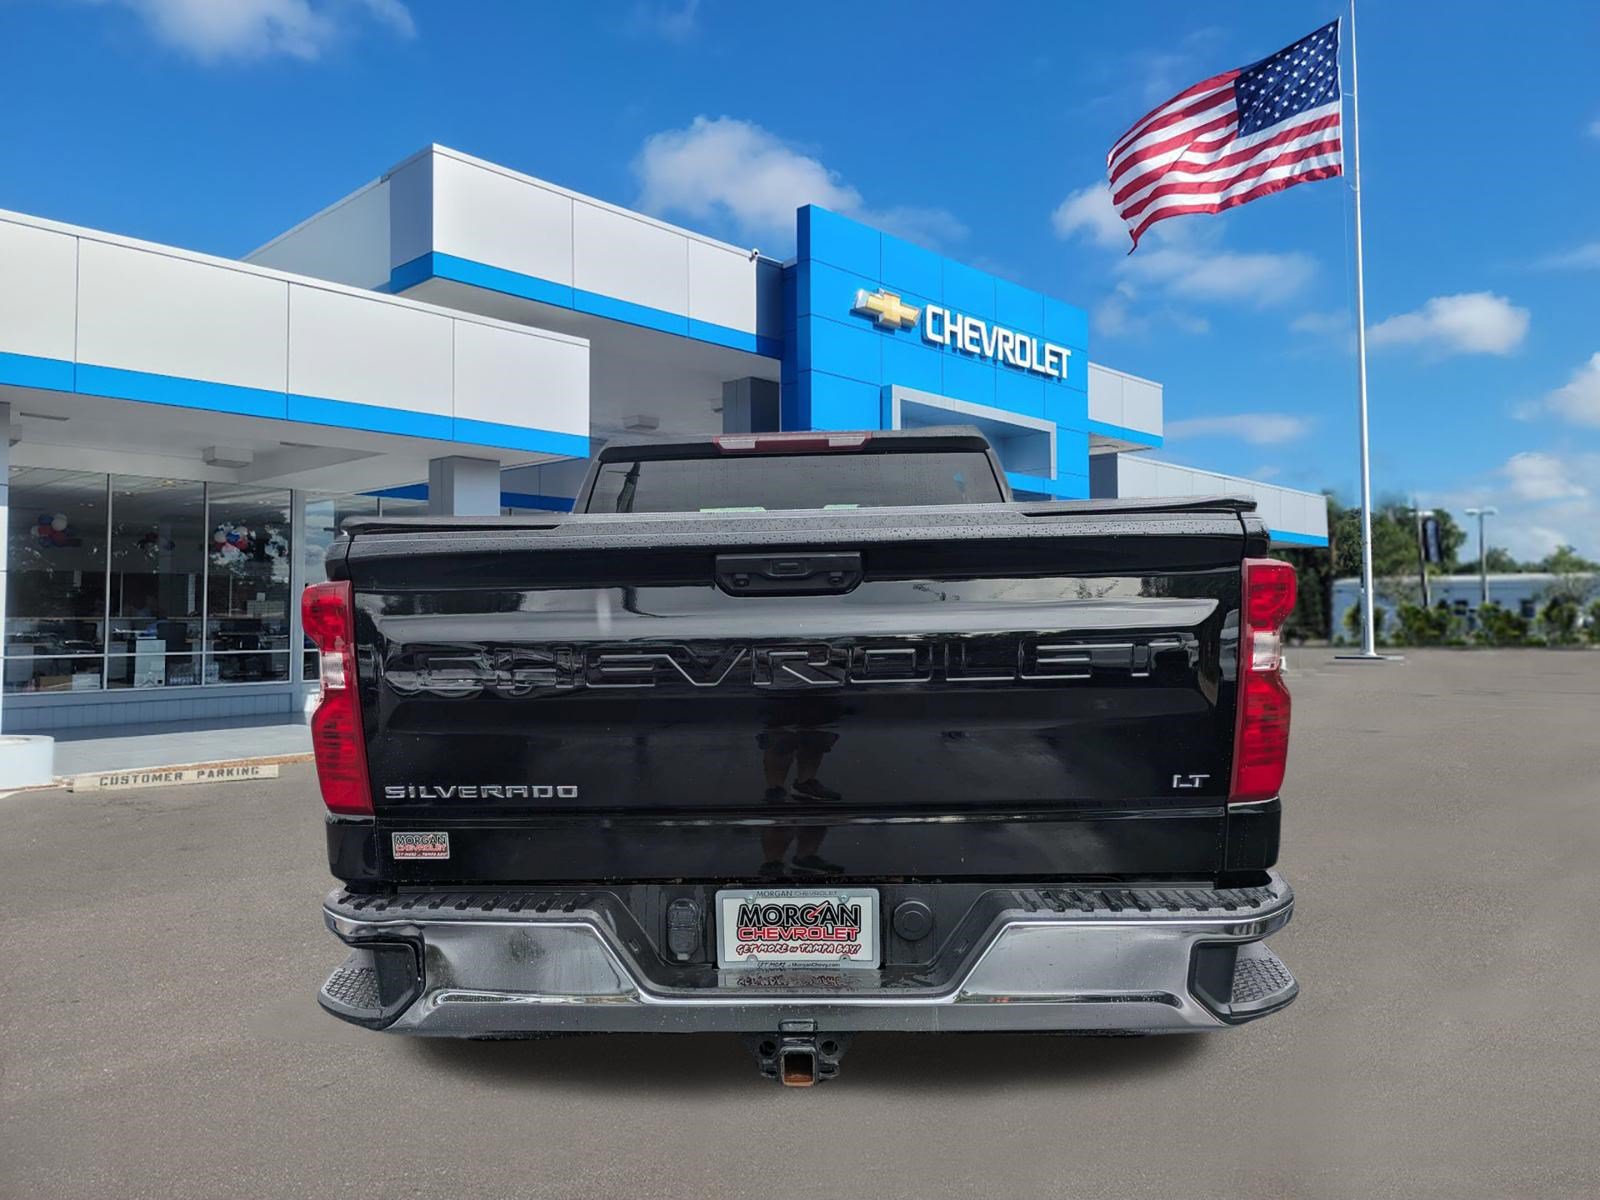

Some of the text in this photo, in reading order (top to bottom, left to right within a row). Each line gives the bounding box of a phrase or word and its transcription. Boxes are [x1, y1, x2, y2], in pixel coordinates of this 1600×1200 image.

[924, 303, 1072, 379] CHEVROLET
[99, 766, 260, 786] CUSTOMER PARKING
[1172, 774, 1210, 788] LT
[384, 783, 579, 799] SILVERADO
[395, 834, 447, 845] MORGAN
[737, 900, 862, 928] MORGAN
[737, 926, 861, 942] CHEVROLET
[736, 943, 758, 956] GET
[758, 943, 789, 954] MORE
[799, 943, 835, 954] TAMPA
[836, 943, 862, 955] BAY!
